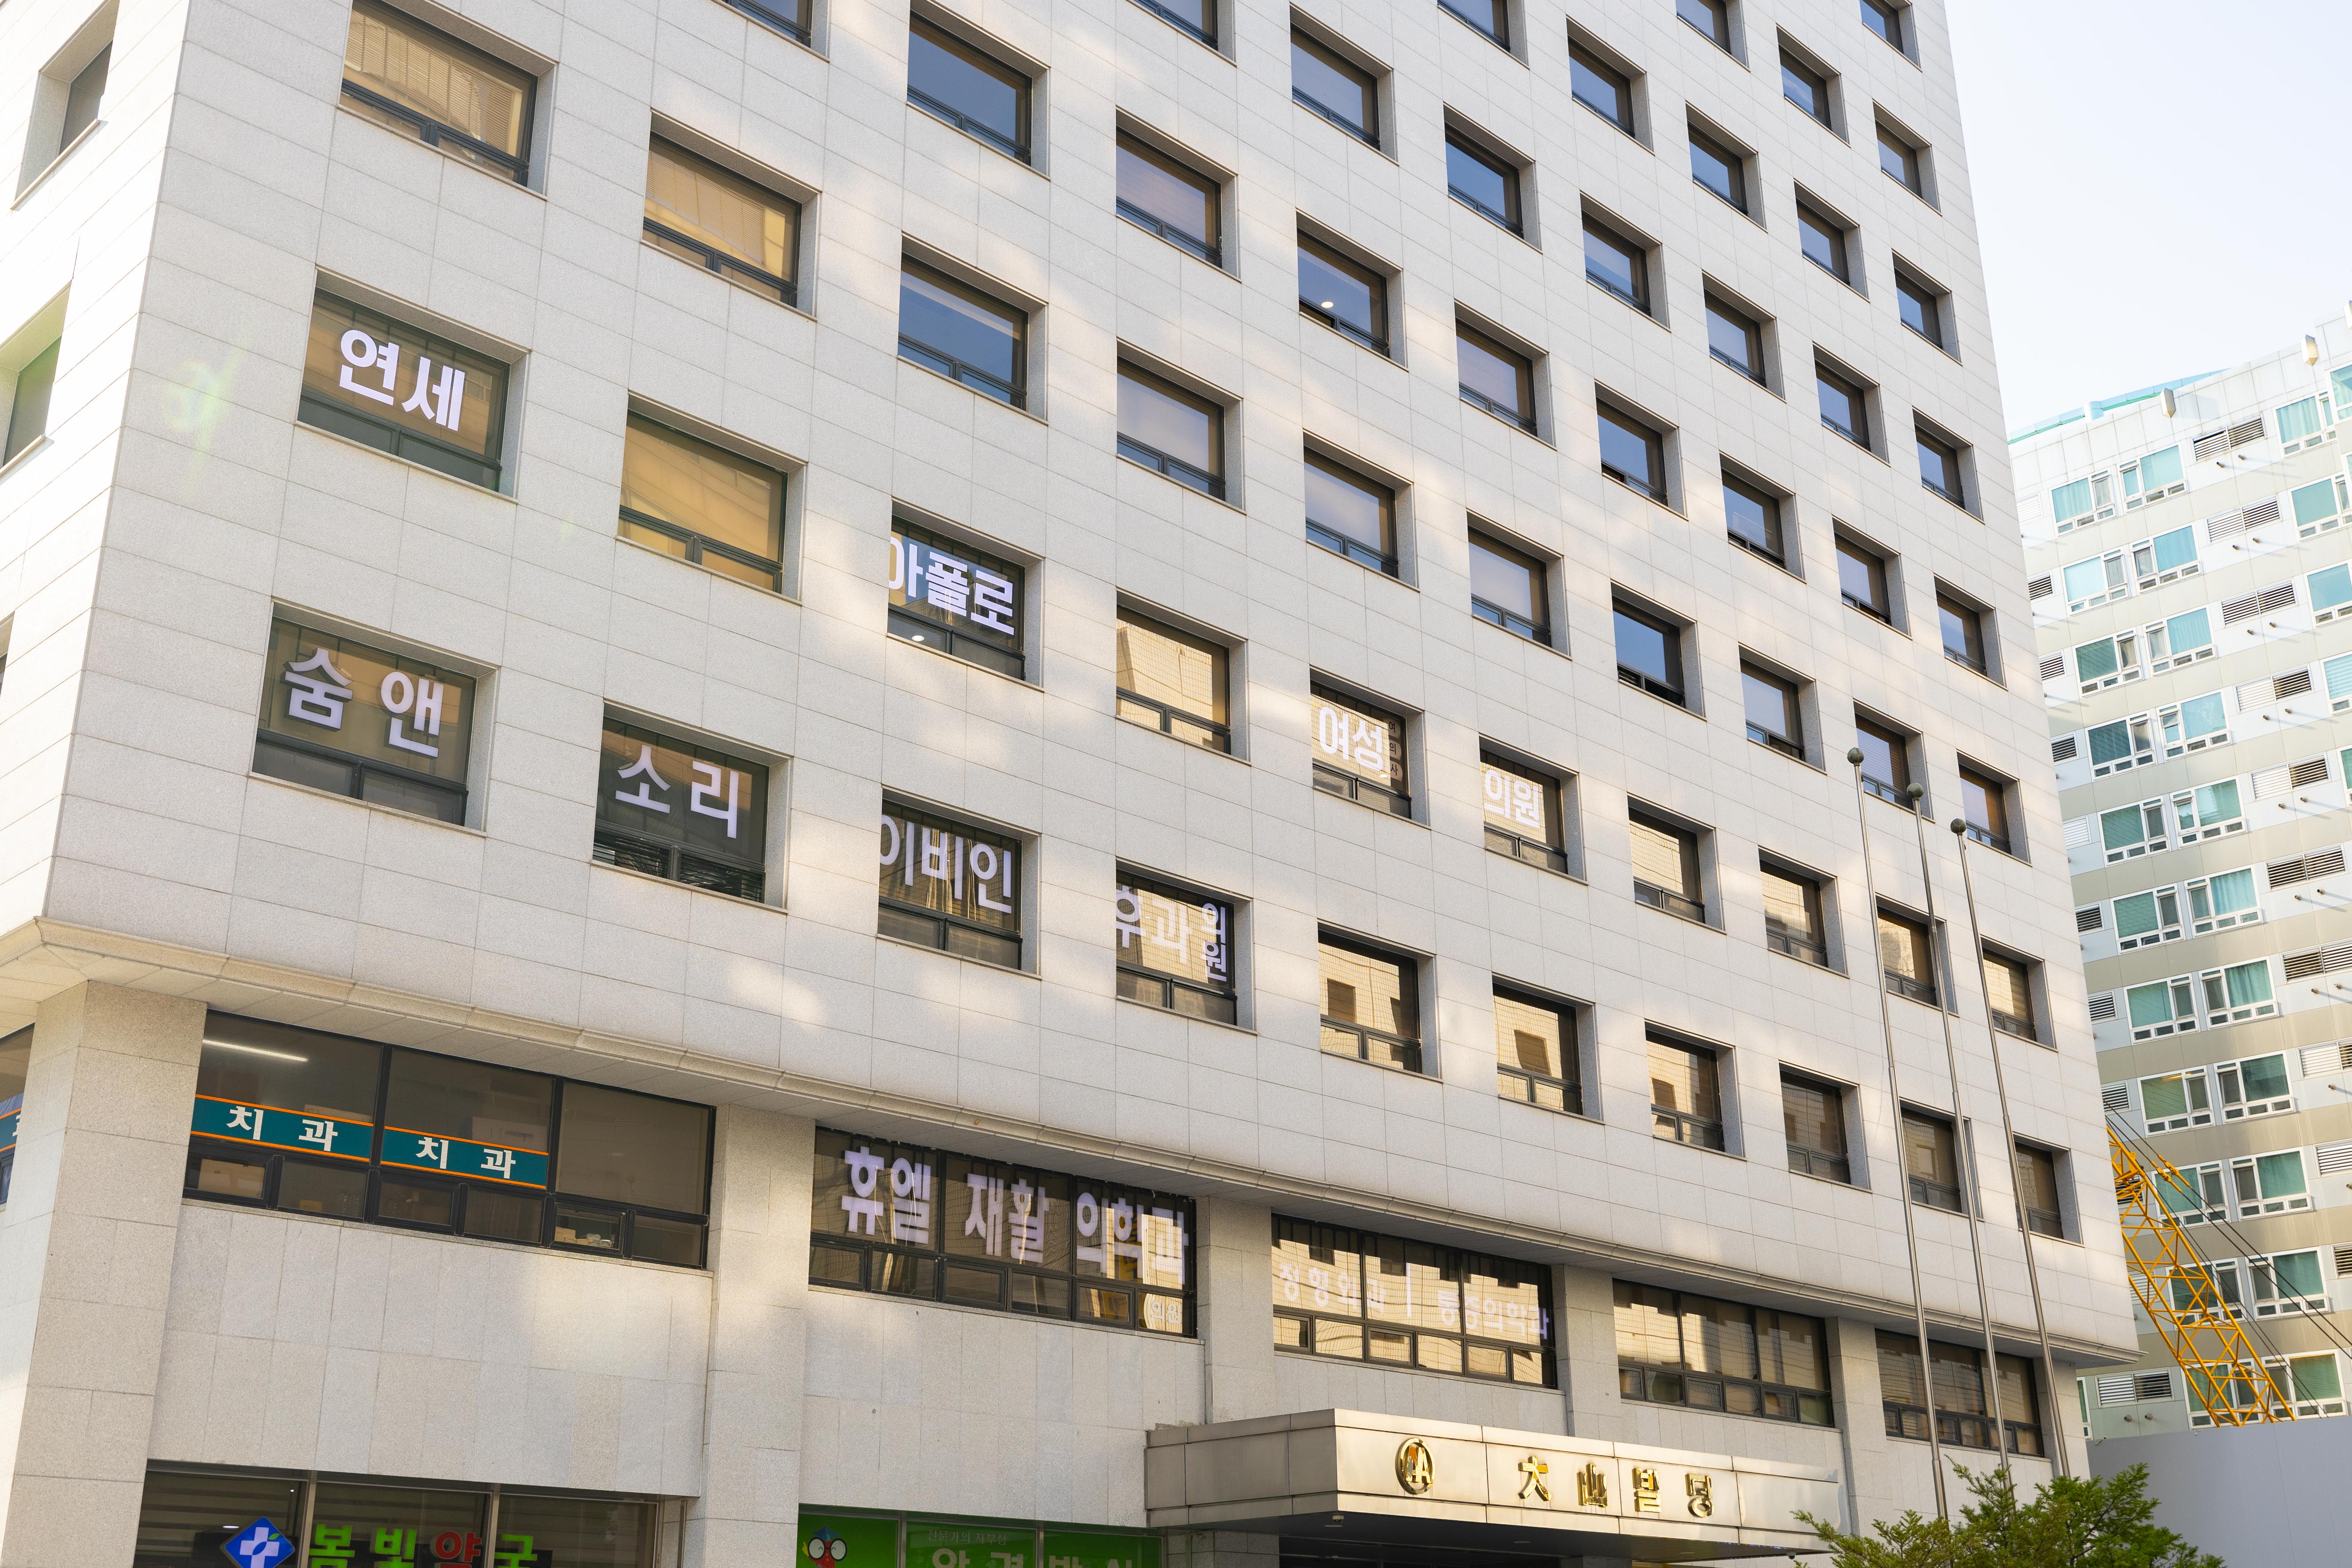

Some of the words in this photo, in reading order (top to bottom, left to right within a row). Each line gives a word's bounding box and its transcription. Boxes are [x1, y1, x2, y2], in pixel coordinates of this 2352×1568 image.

[339, 329, 465, 432] 연세
[888, 536, 1014, 636] 아폴로
[1319, 706, 1384, 771] 여성
[1484, 769, 1540, 829] 의원
[615, 744, 739, 839] 소리
[226, 1105, 338, 1151] 치과
[416, 1136, 516, 1179] 치과
[841, 1146, 931, 1244] 휴엘
[965, 1173, 1050, 1263] 재활
[1151, 1300, 1181, 1325] 의원
